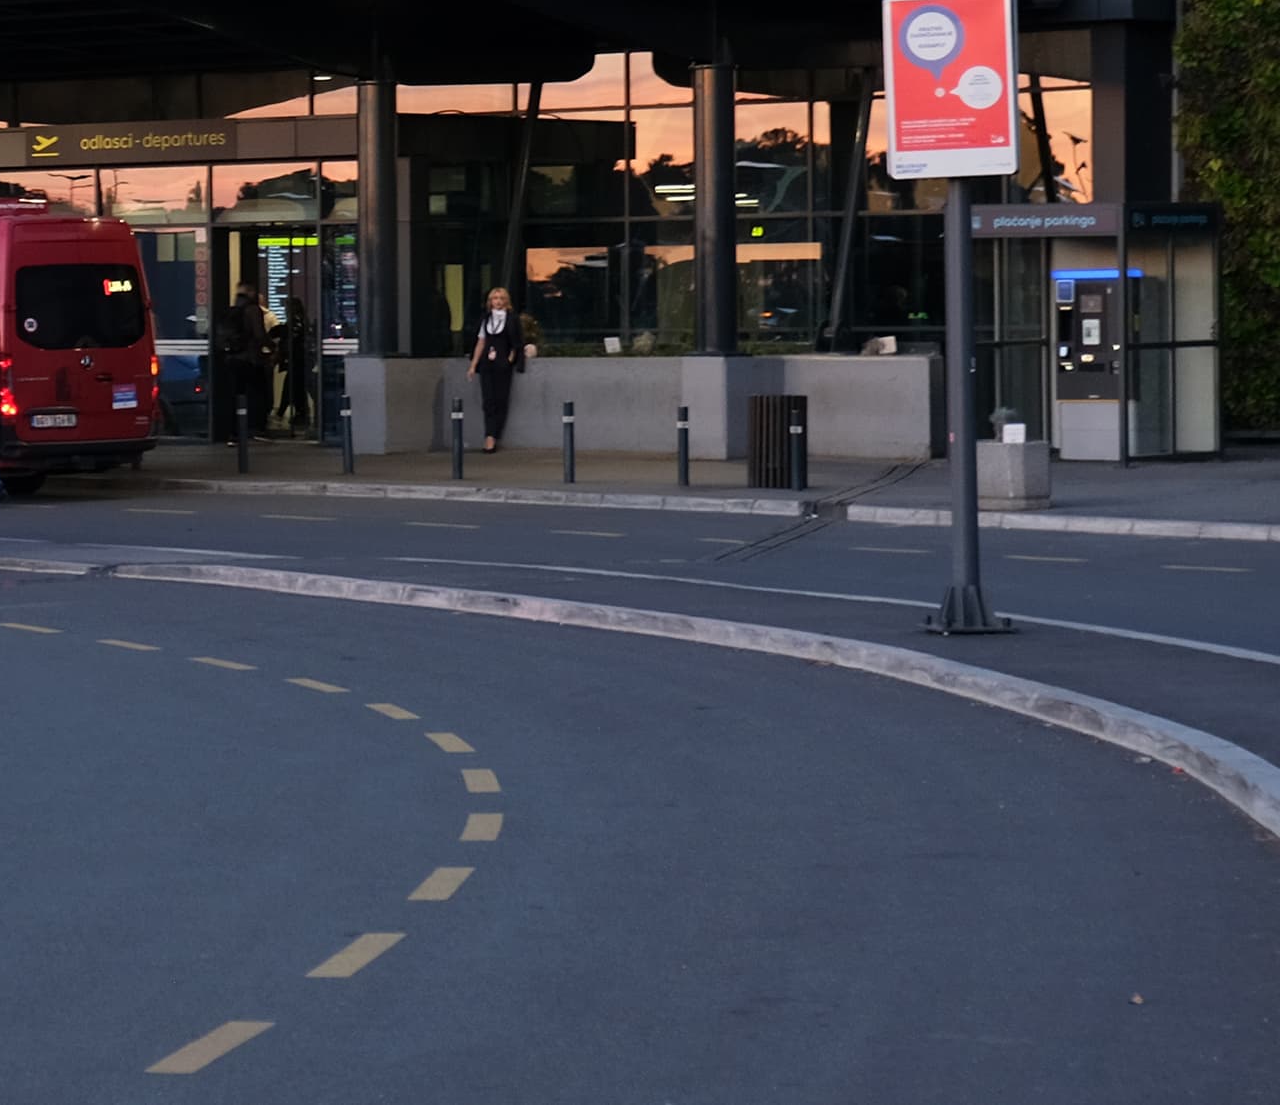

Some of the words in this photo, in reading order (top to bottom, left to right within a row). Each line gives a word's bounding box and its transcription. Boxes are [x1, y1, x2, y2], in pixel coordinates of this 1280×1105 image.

[79, 133, 133, 150] odlasci
[142, 132, 226, 151] departures
[1044, 213, 1096, 229] parkinga
